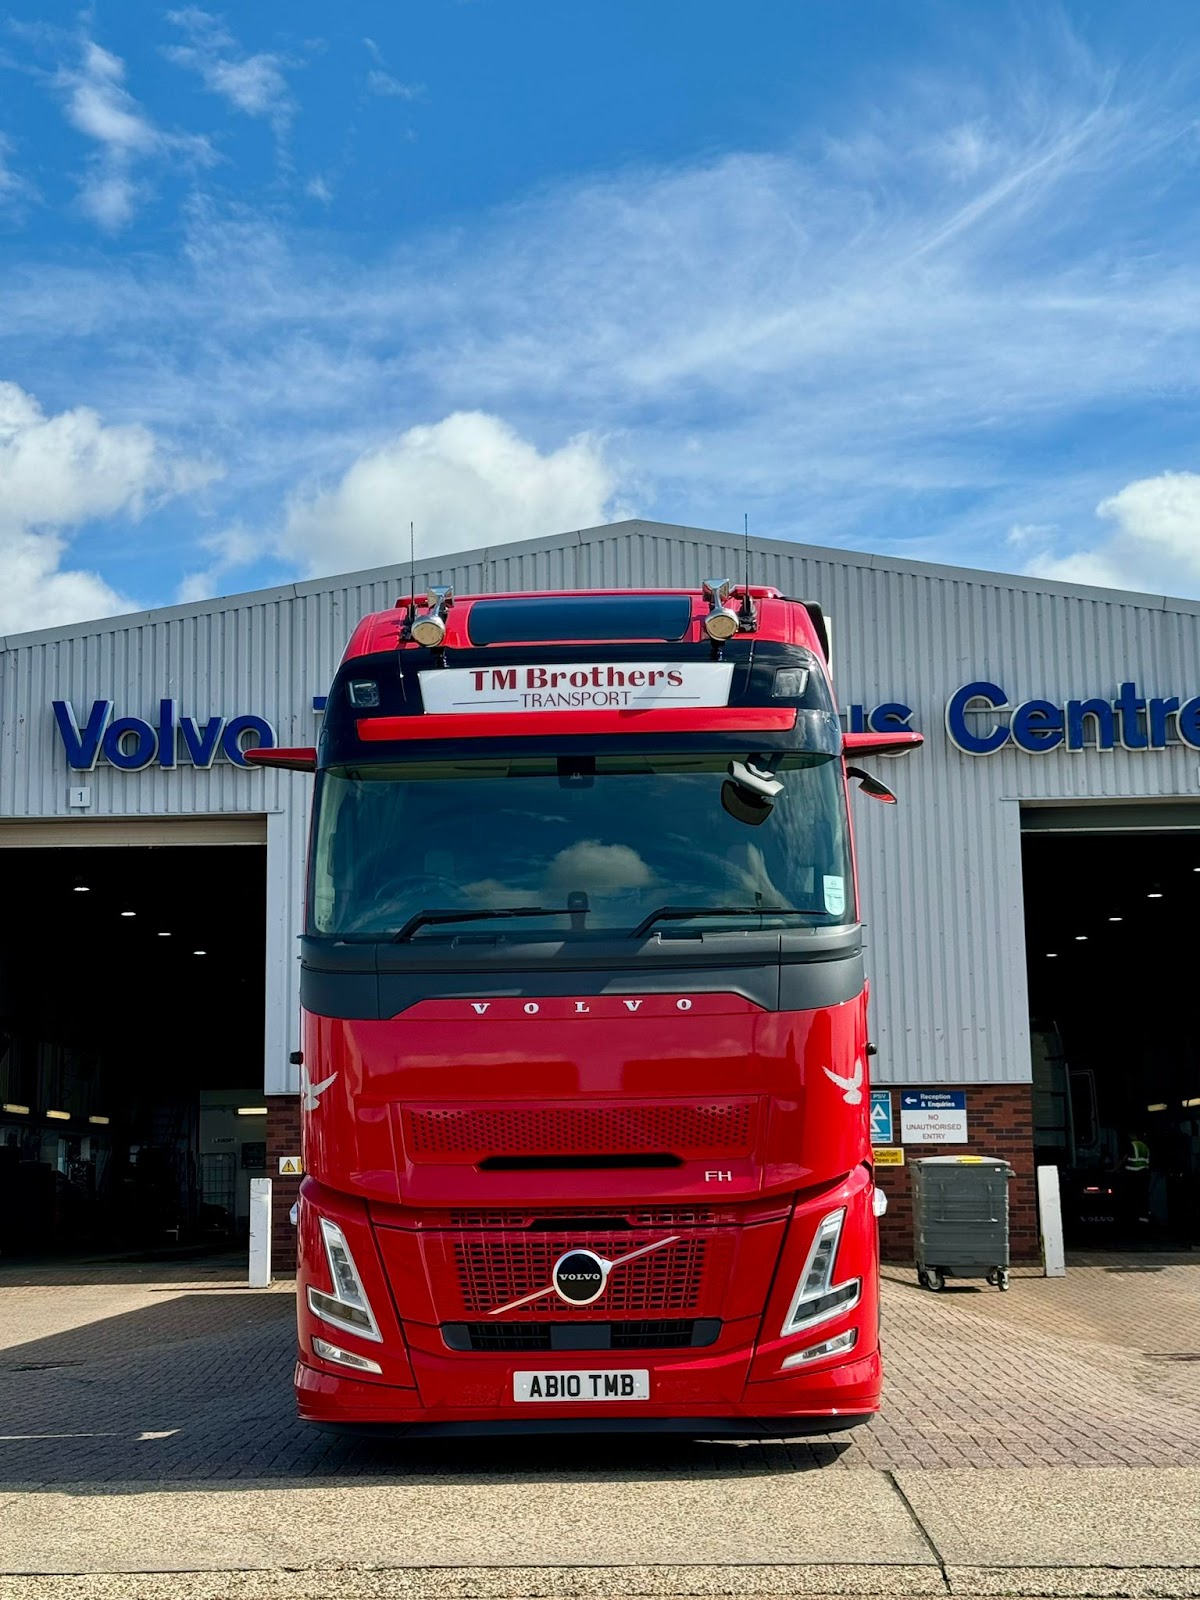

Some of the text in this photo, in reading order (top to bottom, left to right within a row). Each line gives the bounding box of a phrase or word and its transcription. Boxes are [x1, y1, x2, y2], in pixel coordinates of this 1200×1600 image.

[469, 666, 683, 691] TM Brothers
[520, 691, 632, 708] TRANSPORT
[52, 698, 278, 771] Volvo
[471, 999, 692, 1015] VOLVO
[920, 1093, 951, 1101] Reception
[927, 1101, 956, 1109] Enquiries
[704, 1170, 732, 1182] FH
[558, 1273, 601, 1281] VOLVO
[529, 1374, 634, 1397] AB10 TMB
